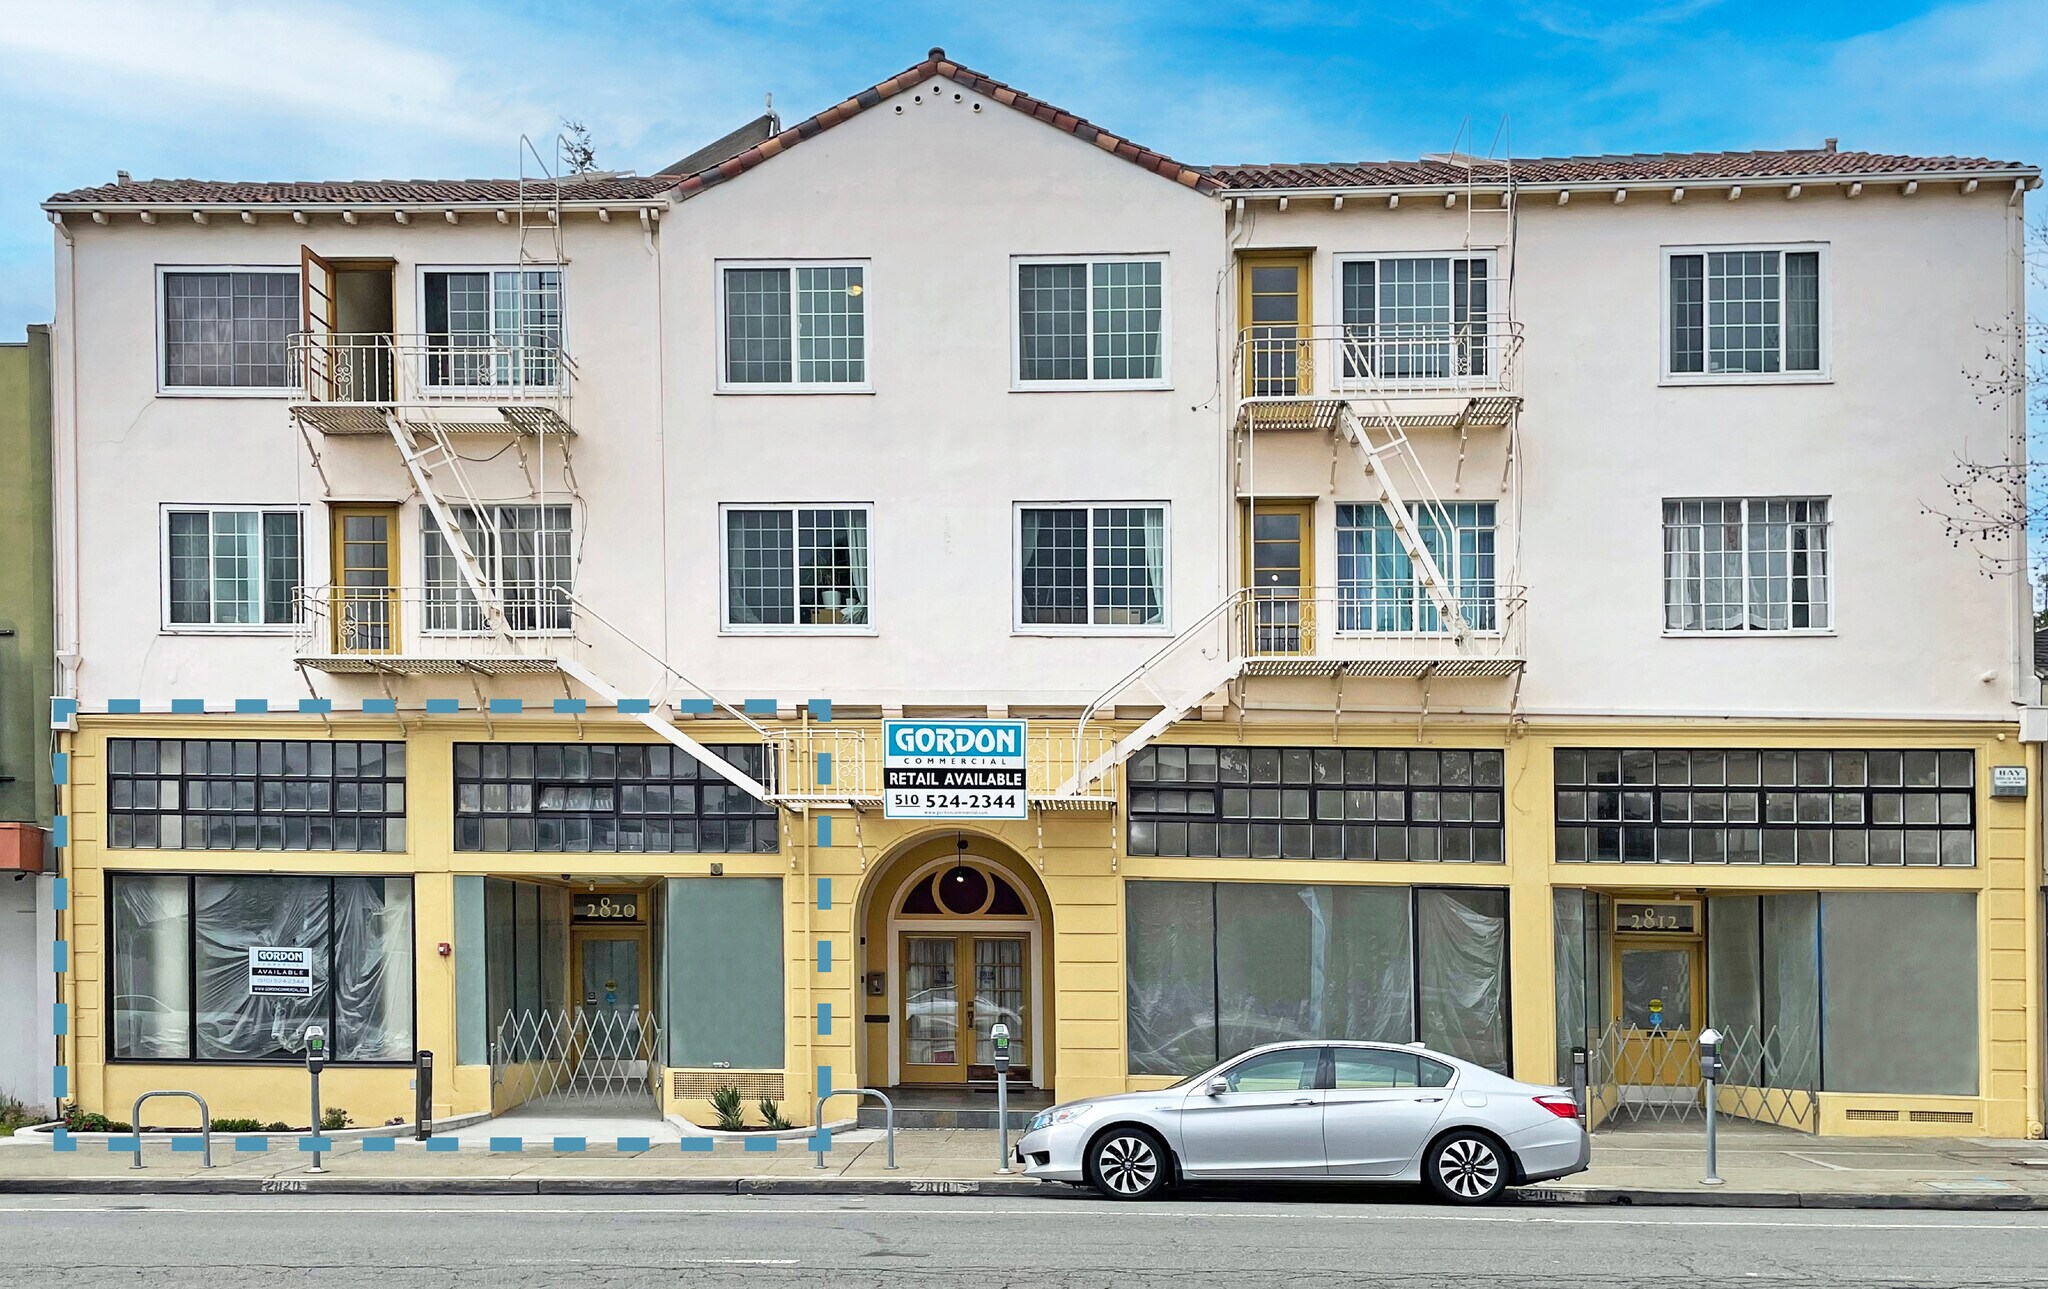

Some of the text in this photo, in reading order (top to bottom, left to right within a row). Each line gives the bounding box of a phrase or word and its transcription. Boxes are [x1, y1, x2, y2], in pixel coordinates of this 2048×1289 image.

[895, 727, 1015, 755] GORDON
[889, 772, 1022, 786] RETAIL AVAILABLE
[895, 794, 1015, 809] 510 524-2344
[587, 897, 636, 918] 2820
[1631, 908, 1679, 929] 2812
[258, 951, 303, 962] GORDON
[257, 968, 304, 976] AVAILABLE
